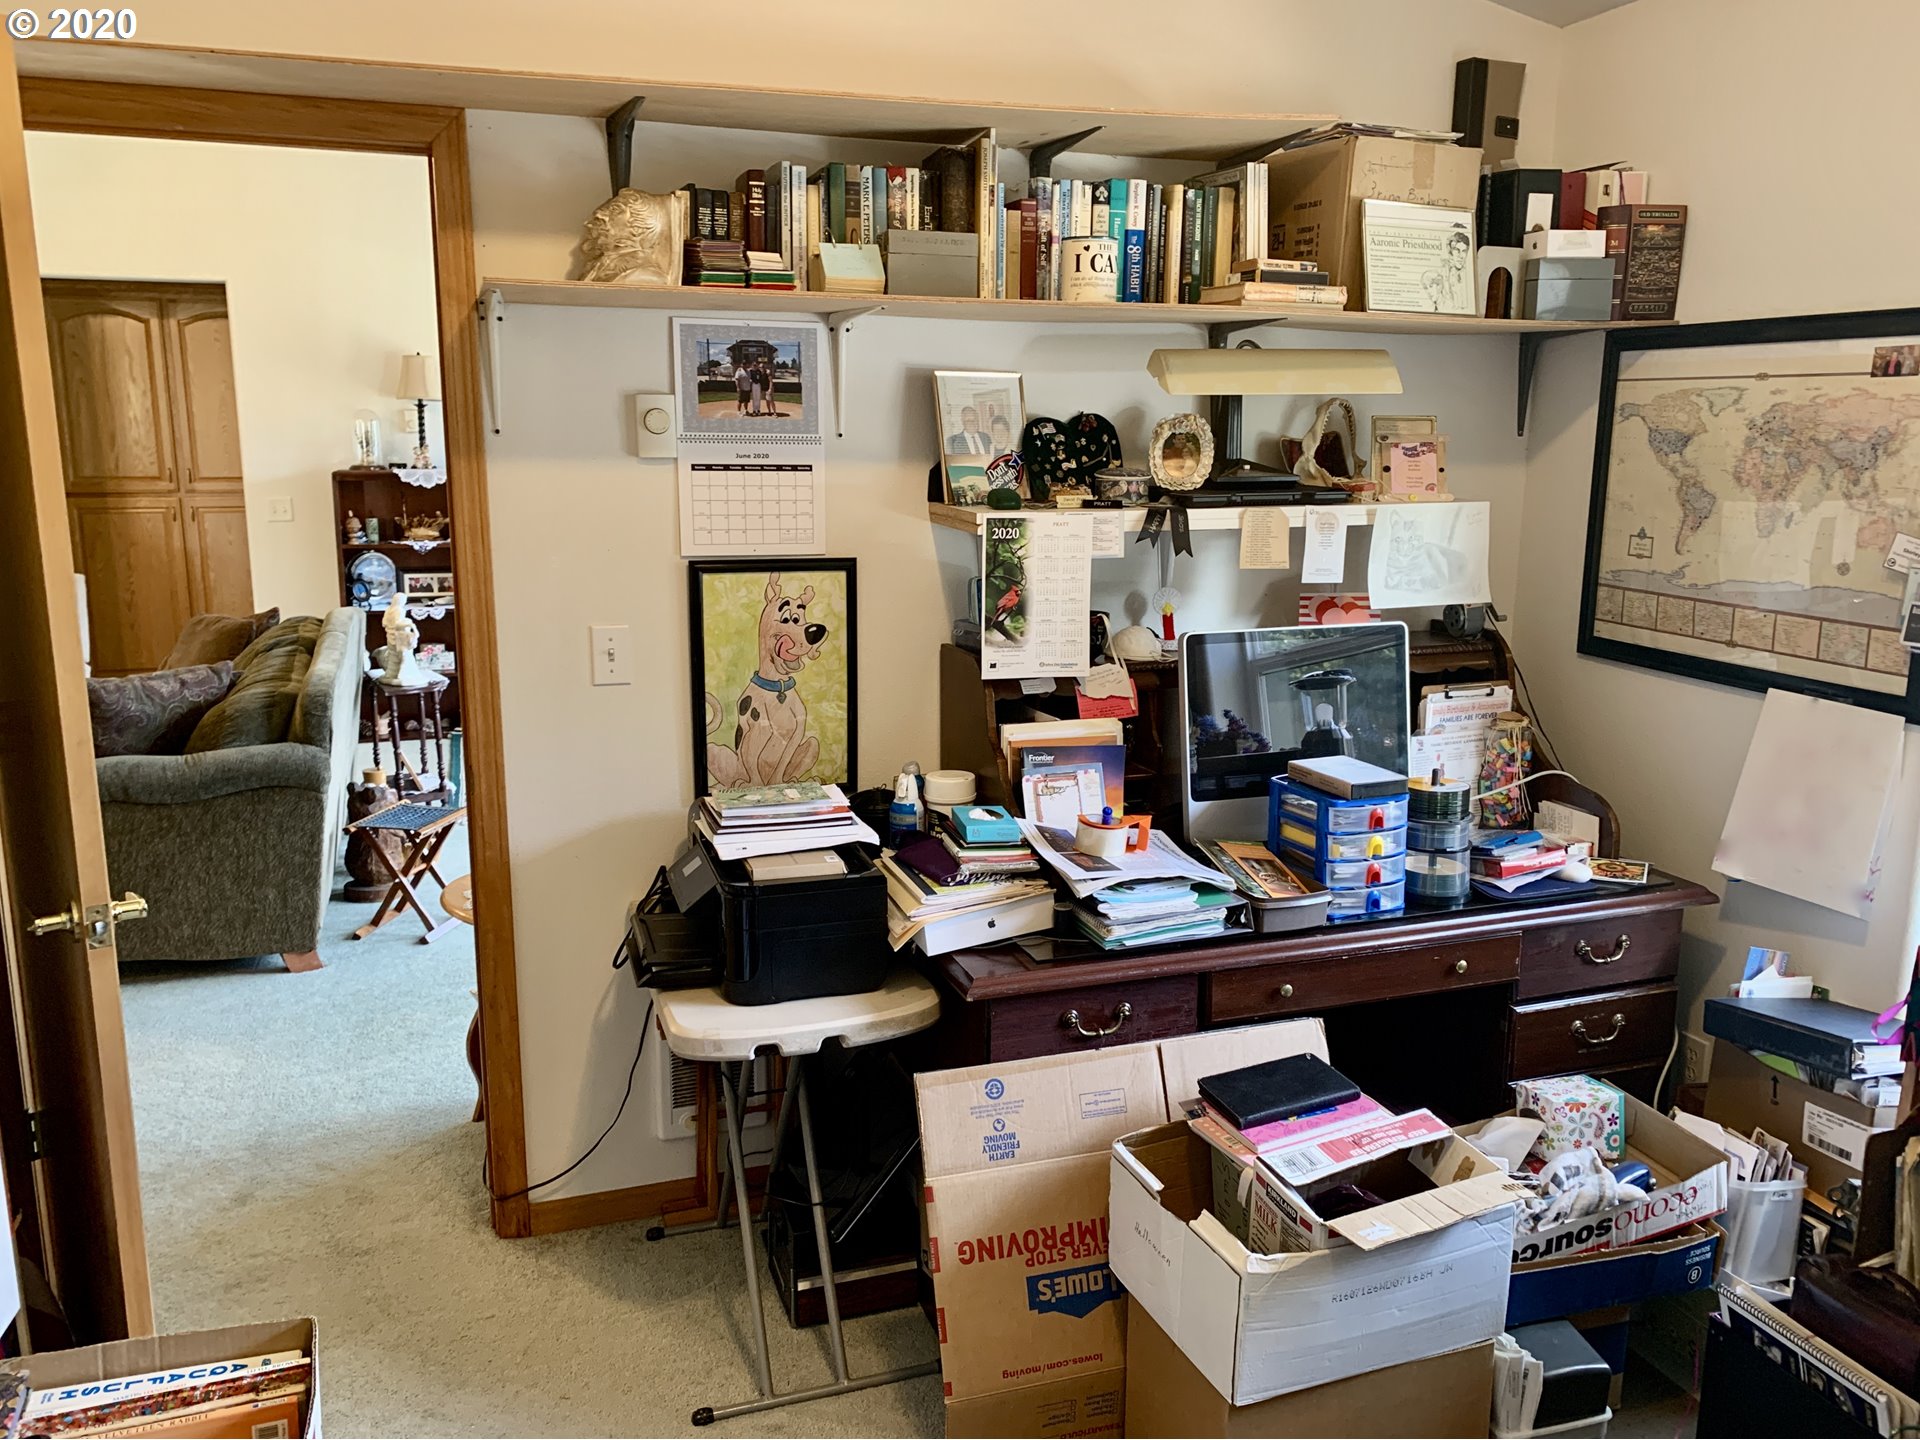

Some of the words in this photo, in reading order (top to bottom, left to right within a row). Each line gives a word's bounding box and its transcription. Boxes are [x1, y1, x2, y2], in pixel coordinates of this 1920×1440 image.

[862, 176, 870, 204] MARK
[924, 206, 932, 223] Ezra
[1370, 237, 1400, 248] Aaronic
[1402, 240, 1442, 250] Priesthood
[1127, 245, 1142, 263] 8th
[1074, 254, 1082, 273] I
[1130, 264, 1140, 294] HABIT
[1003, 467, 1018, 483] with
[992, 528, 1020, 539] 2020
[1440, 714, 1463, 723] FAMILIES
[1476, 712, 1498, 720] FOREVER
[1028, 754, 1054, 762] Frontier
[984, 1132, 1016, 1144] MOVING
[982, 1140, 1020, 1154] FRIENDLY
[989, 1151, 1015, 1162] EARTH
[1268, 1184, 1297, 1218] KIRKLAND
[1255, 1200, 1278, 1234] MILK
[958, 1216, 1109, 1266] IMPROVING
[1134, 1221, 1170, 1267] Halloween
[1025, 1246, 1066, 1268] STOP
[1685, 1252, 1712, 1265] BUSINESS
[1689, 1245, 1712, 1257] SOURCE
[1002, 1353, 1103, 1379] lowes.com/moving
